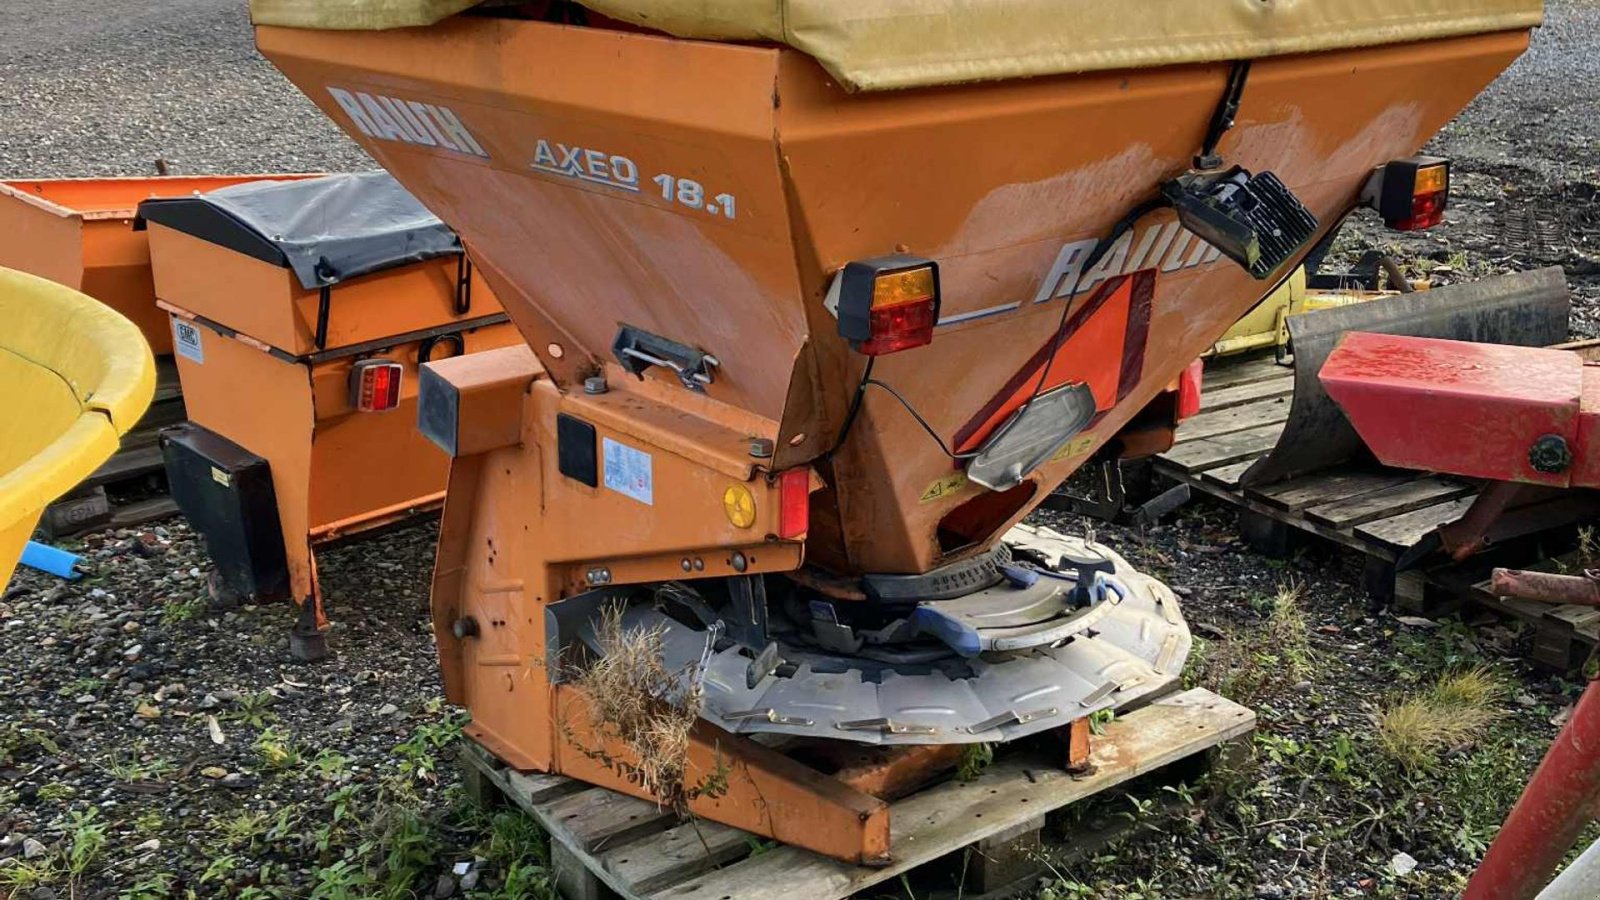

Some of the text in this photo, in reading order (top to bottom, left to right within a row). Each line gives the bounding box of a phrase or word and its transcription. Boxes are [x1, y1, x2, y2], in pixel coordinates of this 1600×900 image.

[325, 86, 492, 159] RAUCH
[532, 139, 736, 219] AXEO 18.1
